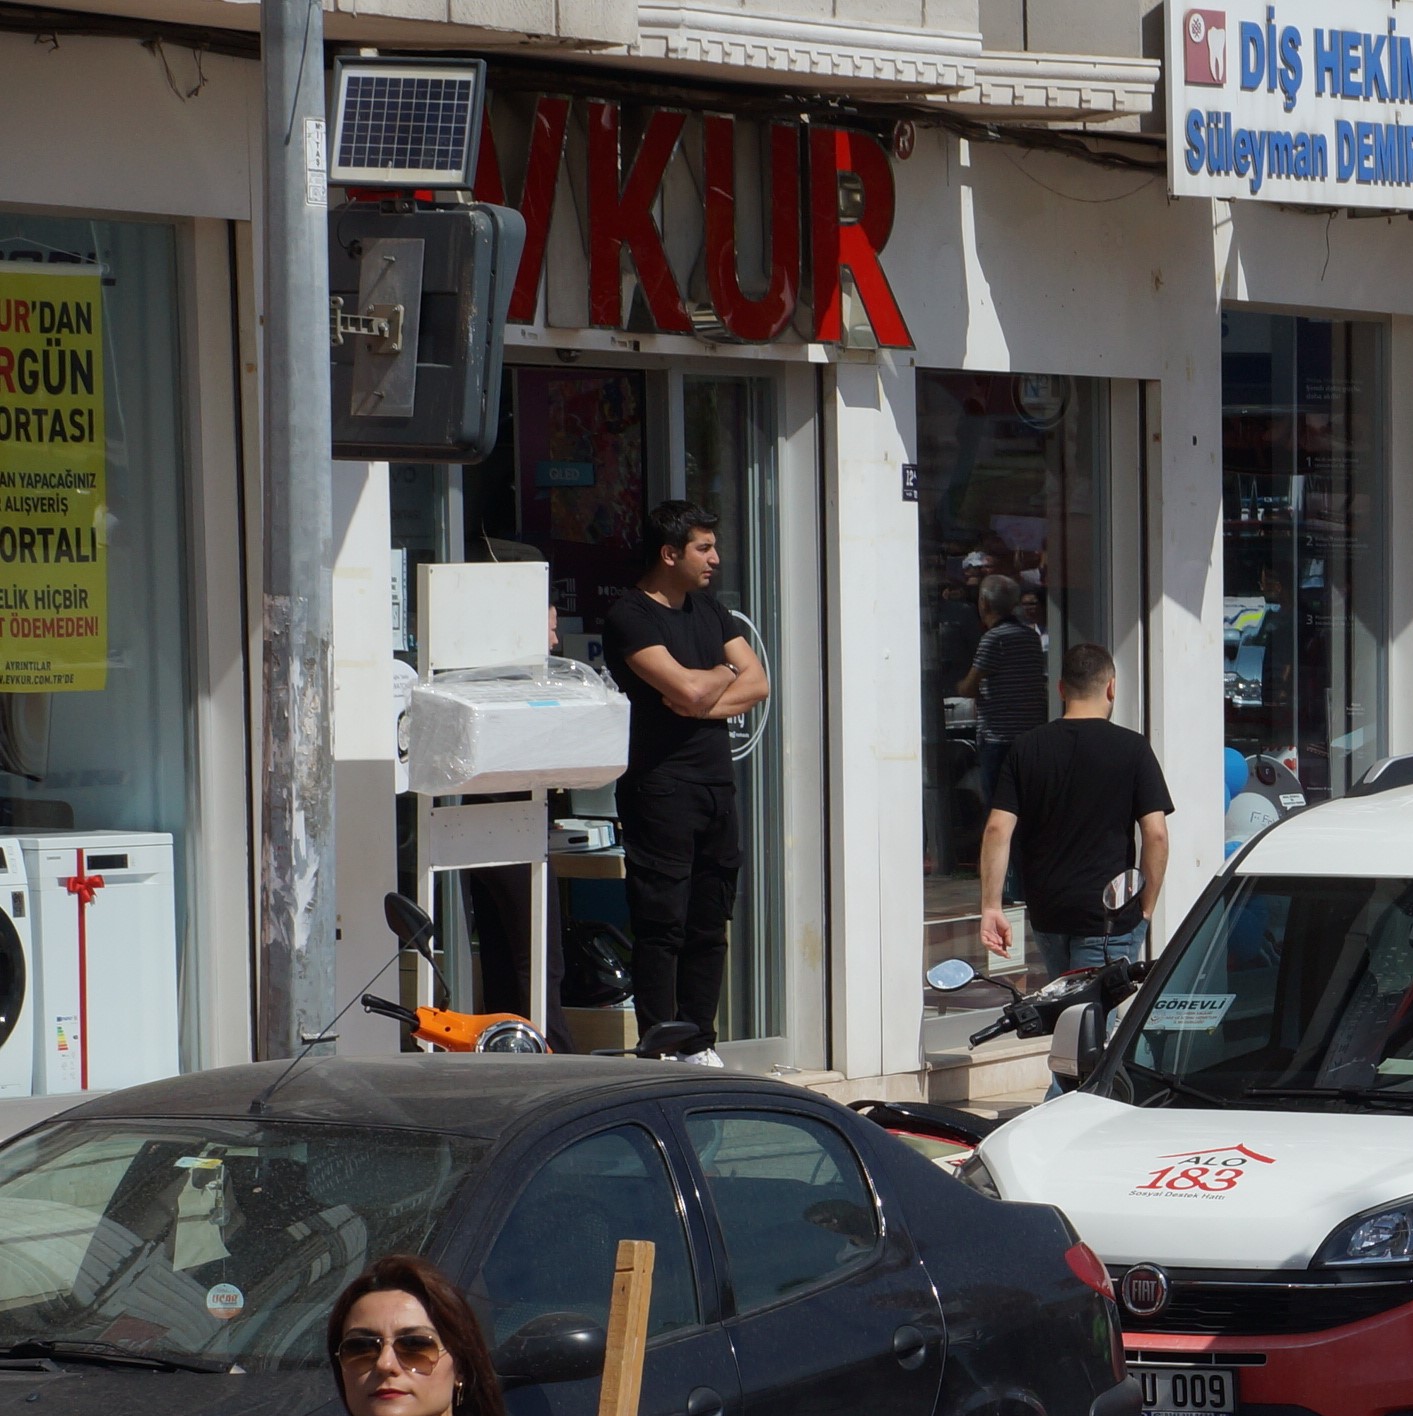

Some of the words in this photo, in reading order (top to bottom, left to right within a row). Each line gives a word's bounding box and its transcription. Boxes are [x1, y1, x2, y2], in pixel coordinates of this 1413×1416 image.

[1240, 5, 1303, 112] DİŞ
[1185, 108, 1327, 194] Süleyman
[20, 469, 96, 489] YAPACAĞINIZ
[5, 494, 68, 515] ALIŞVERİŞ
[34, 584, 88, 613] HİÇBİR
[10, 613, 98, 638] ÖDEMEDEN!
[5, 661, 51, 671] AYRINTILAR
[1155, 998, 1227, 1010] GÖREVLİ
[1178, 1155, 1247, 1167] ALO
[1136, 1166, 1244, 1192] 183
[1128, 1190, 1163, 1198] Sosyal
[1165, 1191, 1198, 1199] Destek
[1132, 1279, 1158, 1301] FIAT
[1172, 1374, 1226, 1409] 009
